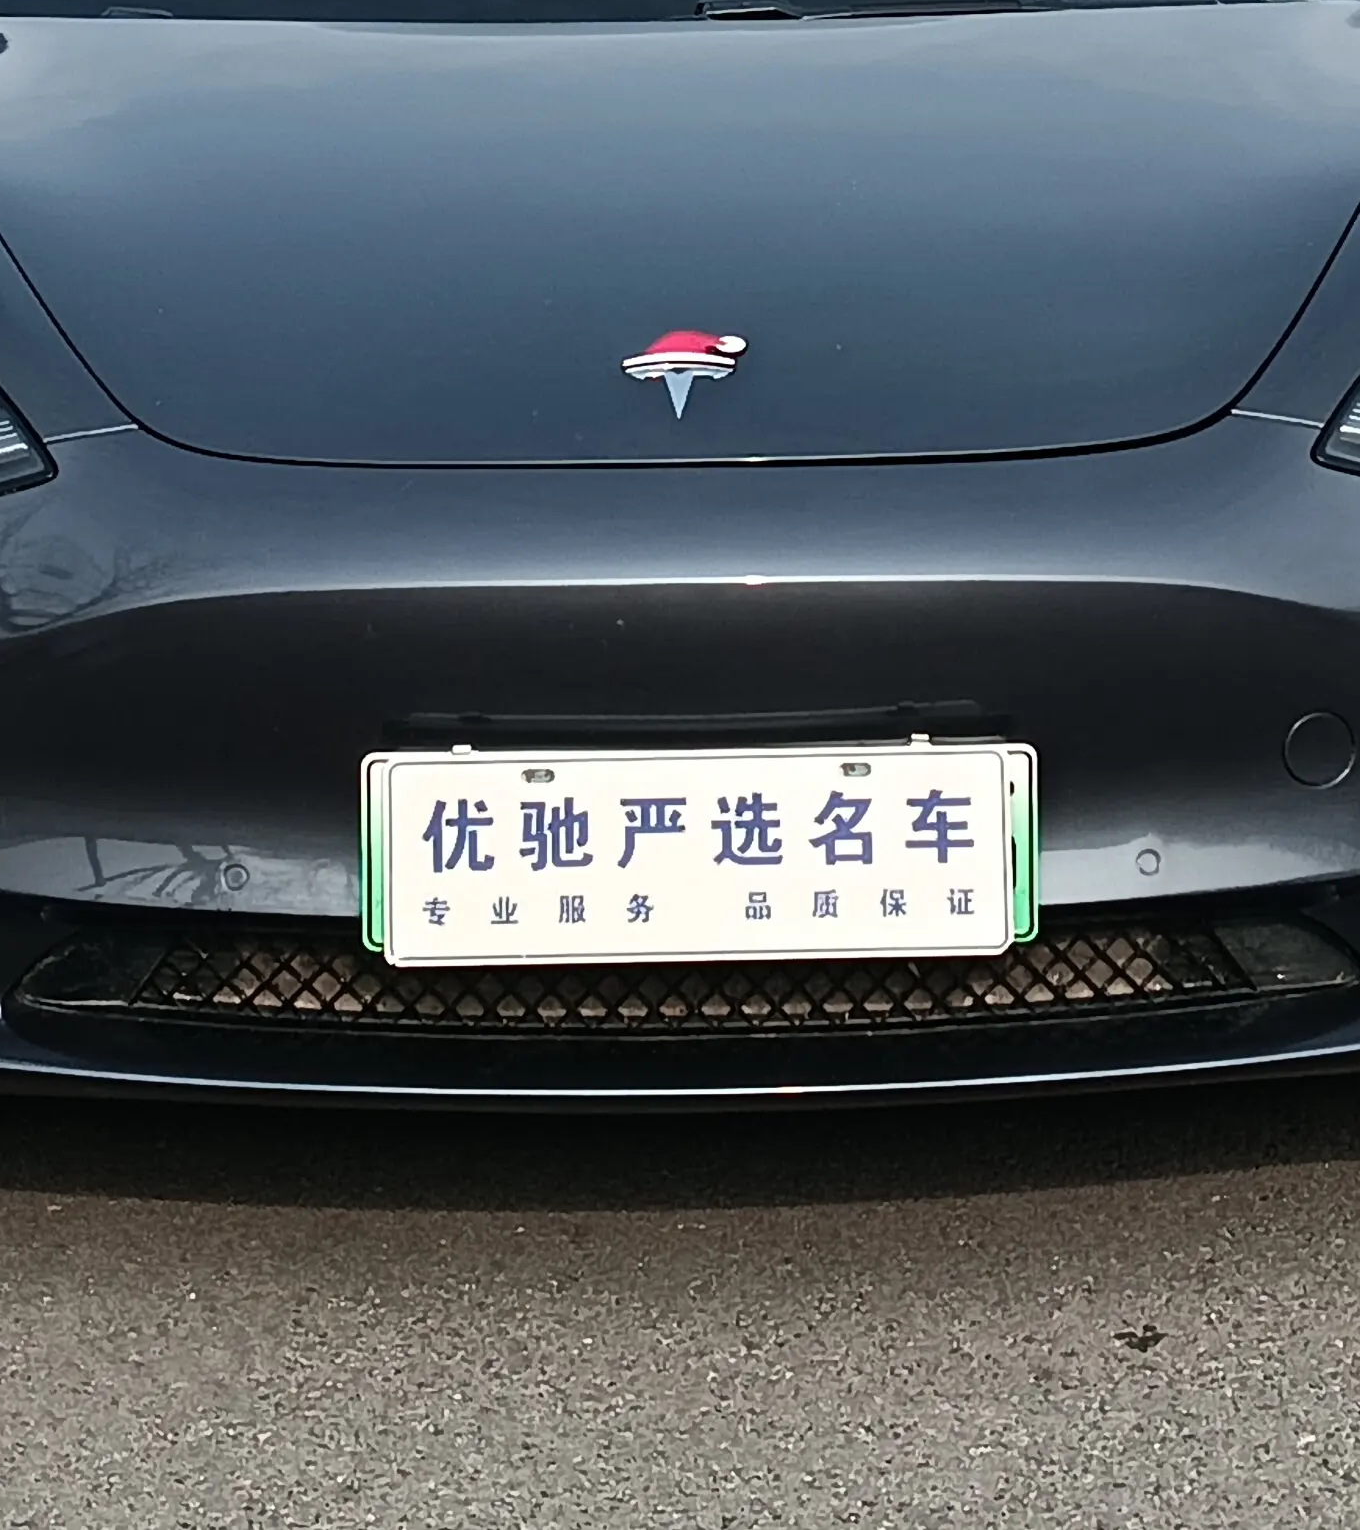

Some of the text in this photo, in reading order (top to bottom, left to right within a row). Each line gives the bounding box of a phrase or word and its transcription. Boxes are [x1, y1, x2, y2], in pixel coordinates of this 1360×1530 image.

[423, 789, 974, 872] 优驰严选名车
